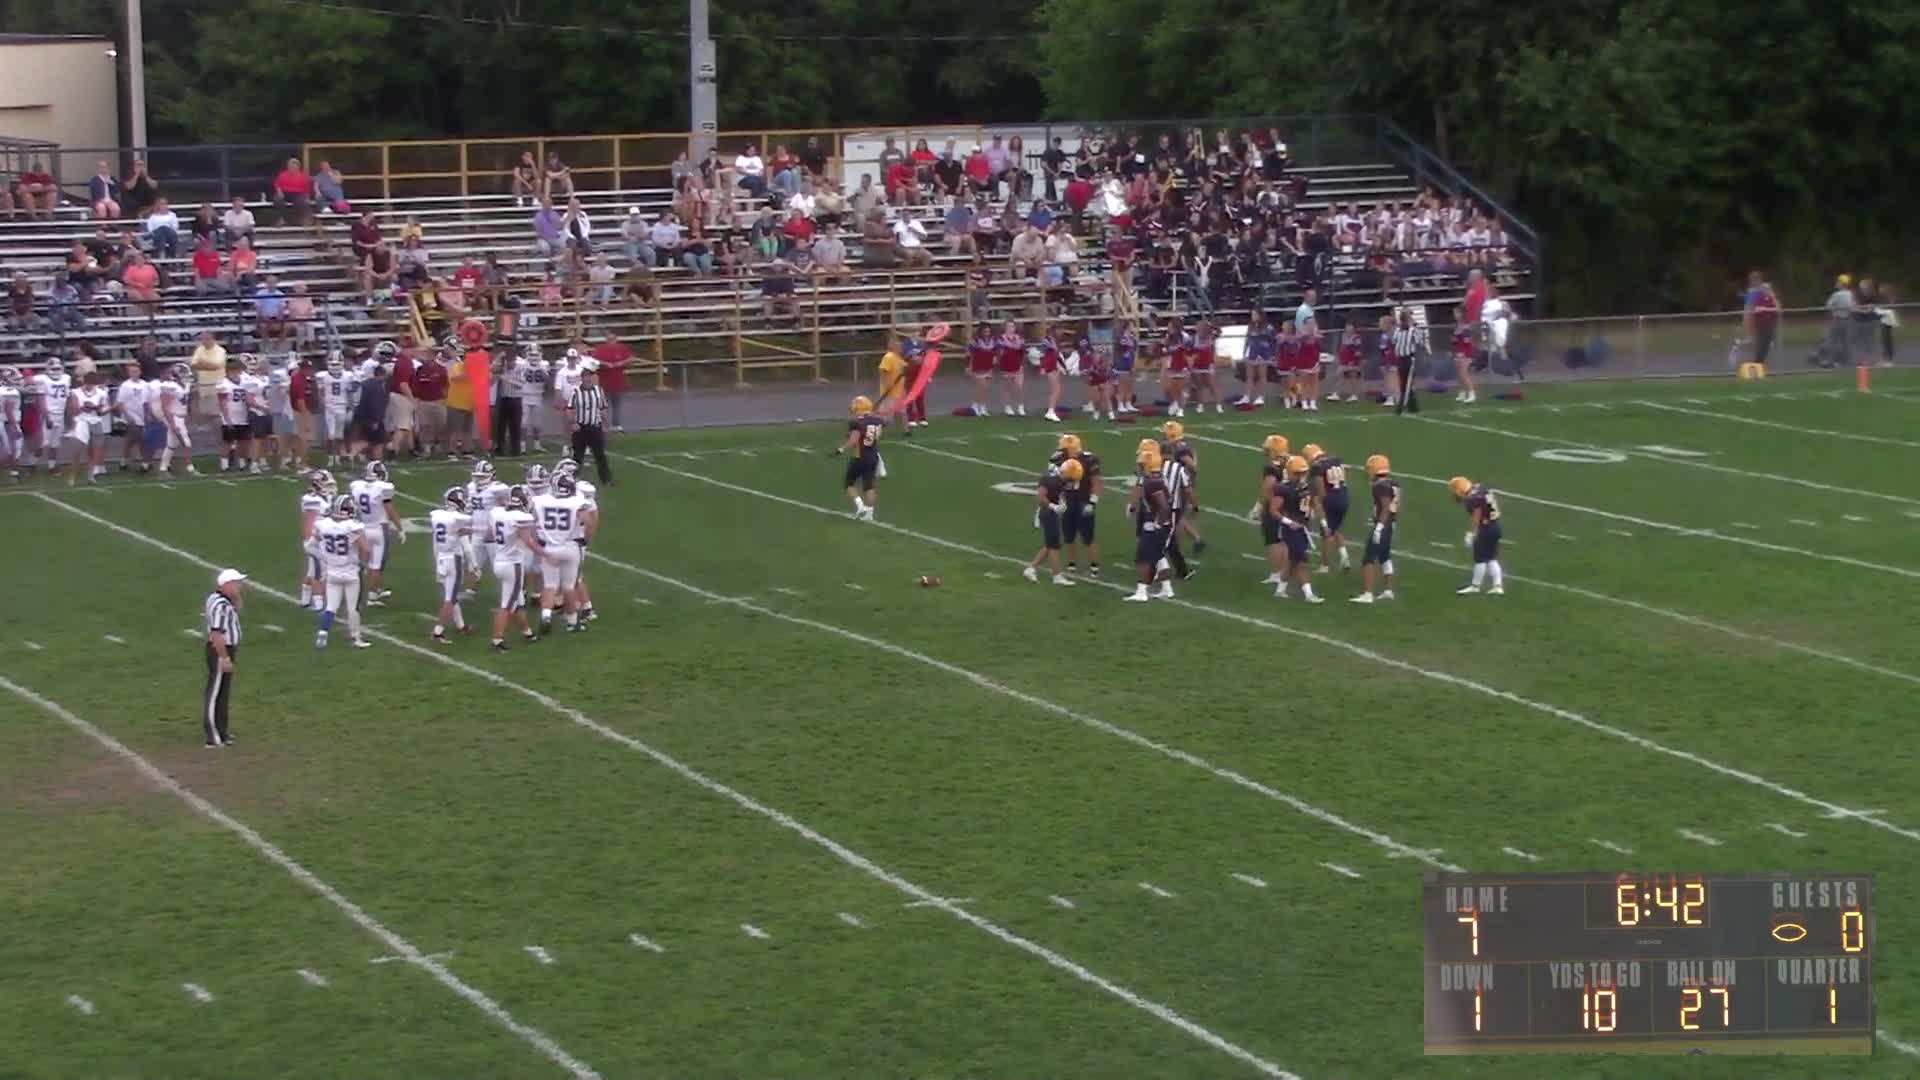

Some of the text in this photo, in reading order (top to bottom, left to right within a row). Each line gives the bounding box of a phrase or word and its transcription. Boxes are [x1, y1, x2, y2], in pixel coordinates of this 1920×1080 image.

[359, 493, 372, 515] 9
[543, 506, 572, 532] 53
[435, 523, 447, 543] 2
[322, 533, 350, 556] 33
